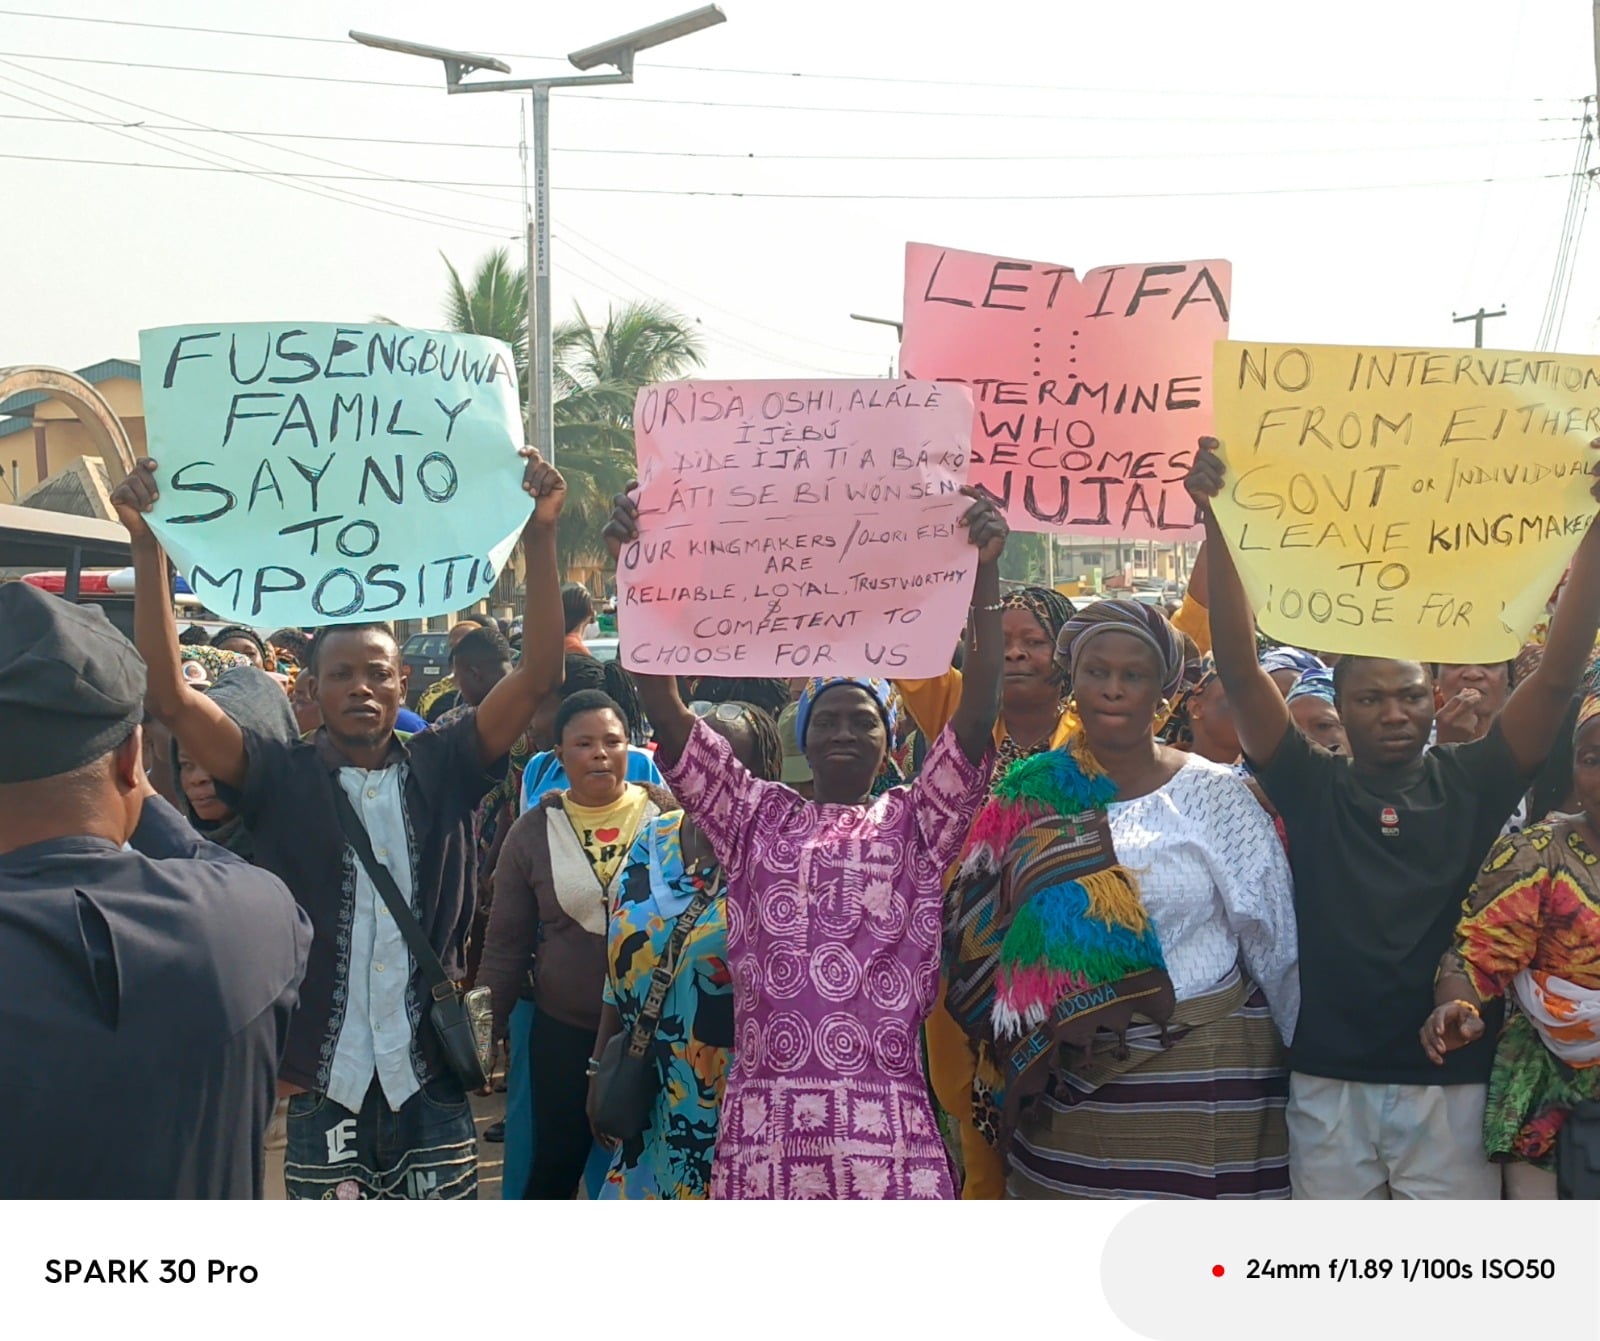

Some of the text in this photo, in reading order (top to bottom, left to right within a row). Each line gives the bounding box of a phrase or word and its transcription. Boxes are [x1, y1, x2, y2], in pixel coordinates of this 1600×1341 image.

[924, 251, 1230, 322] LET IFA
[163, 329, 514, 388] FUSENGBUWA
[1238, 347, 1600, 393] NO INTERVENTION
[904, 370, 1203, 414] TERMINE
[222, 393, 472, 447] FAMILY
[980, 411, 1095, 448] WHO
[1253, 403, 1600, 454] FROM EITHER
[166, 451, 458, 524] SAY NO
[1232, 464, 1401, 519] GOVT
[279, 515, 379, 557] TO
[625, 540, 676, 570] OUR
[1239, 522, 1410, 553] LEAVE
[765, 556, 814, 574] ARE
[849, 569, 967, 592] TRUSTWORTHY
[1337, 561, 1410, 591] TO
[693, 608, 922, 638] COMPETENT TO
[1267, 583, 1395, 626] OOSE
[1417, 593, 1473, 628] FOR
[630, 642, 911, 666] CHOOSE FOR US
